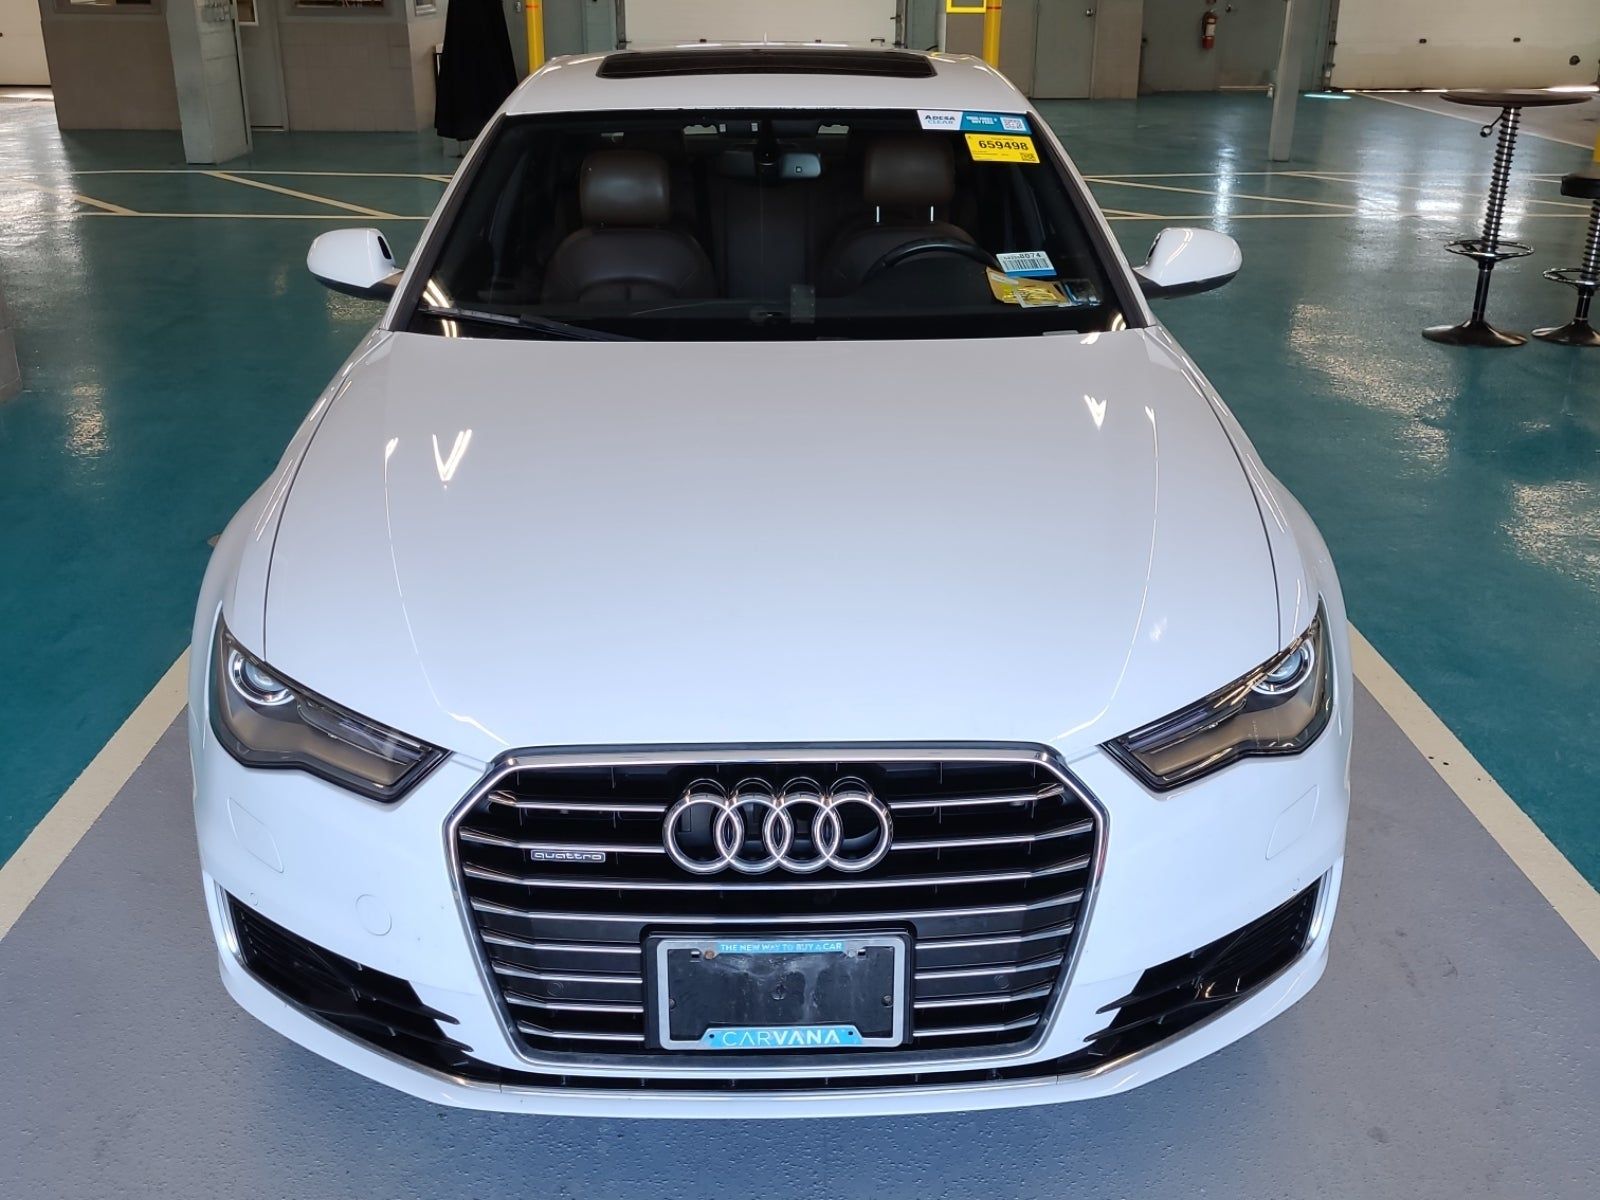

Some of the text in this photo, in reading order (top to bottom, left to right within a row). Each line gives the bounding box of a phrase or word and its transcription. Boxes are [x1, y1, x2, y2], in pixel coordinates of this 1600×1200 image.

[979, 140, 1029, 151] 659498
[533, 852, 602, 860] quattro
[741, 943, 760, 951] NEW
[761, 943, 780, 951] WAY
[782, 943, 793, 951] TO
[796, 942, 814, 951] BUY
[822, 942, 842, 950] CAR
[722, 1029, 840, 1046] CARVANA
